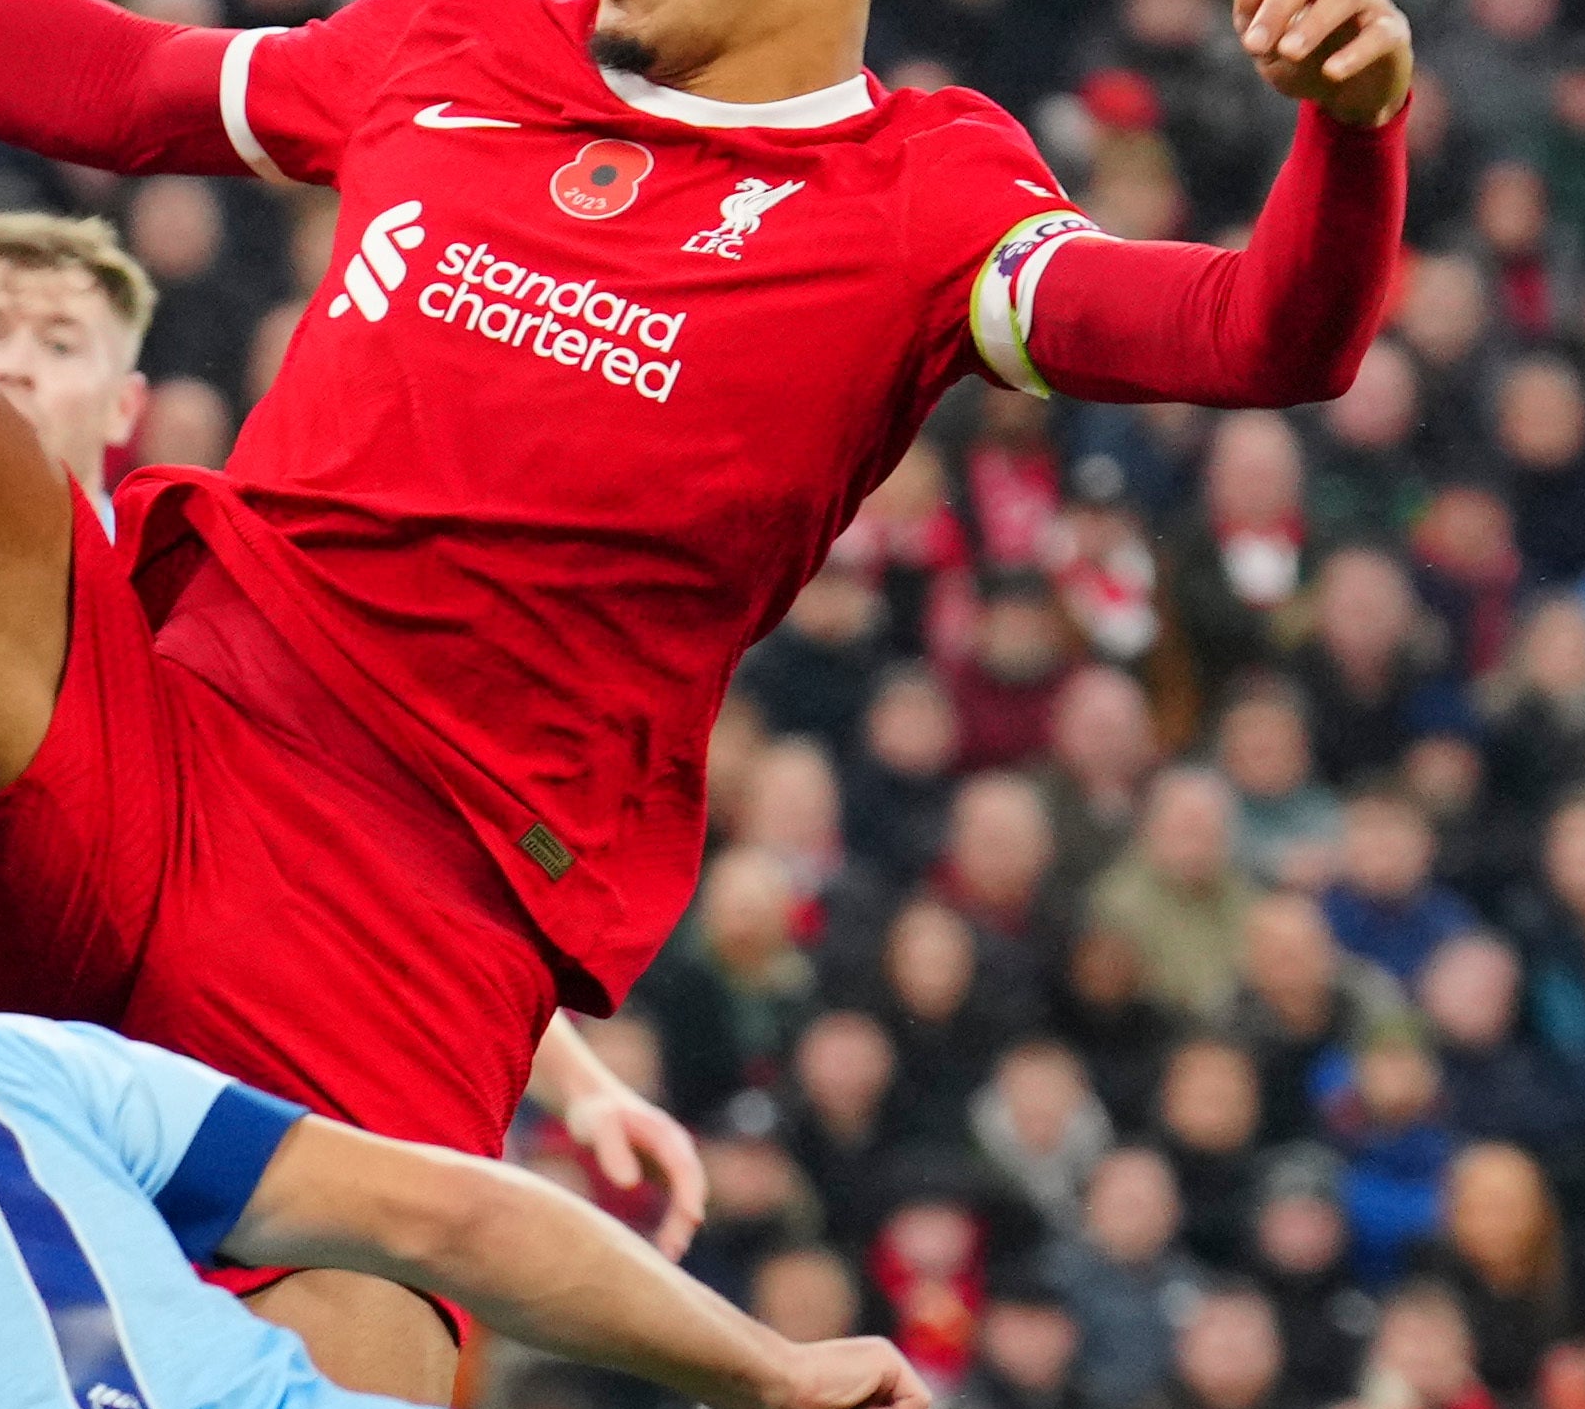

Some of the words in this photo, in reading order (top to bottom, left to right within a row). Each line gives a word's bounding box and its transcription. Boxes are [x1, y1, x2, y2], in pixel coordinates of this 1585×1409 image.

[563, 186, 608, 211] 2023
[418, 280, 682, 404] chartered
[435, 241, 688, 353] standard
